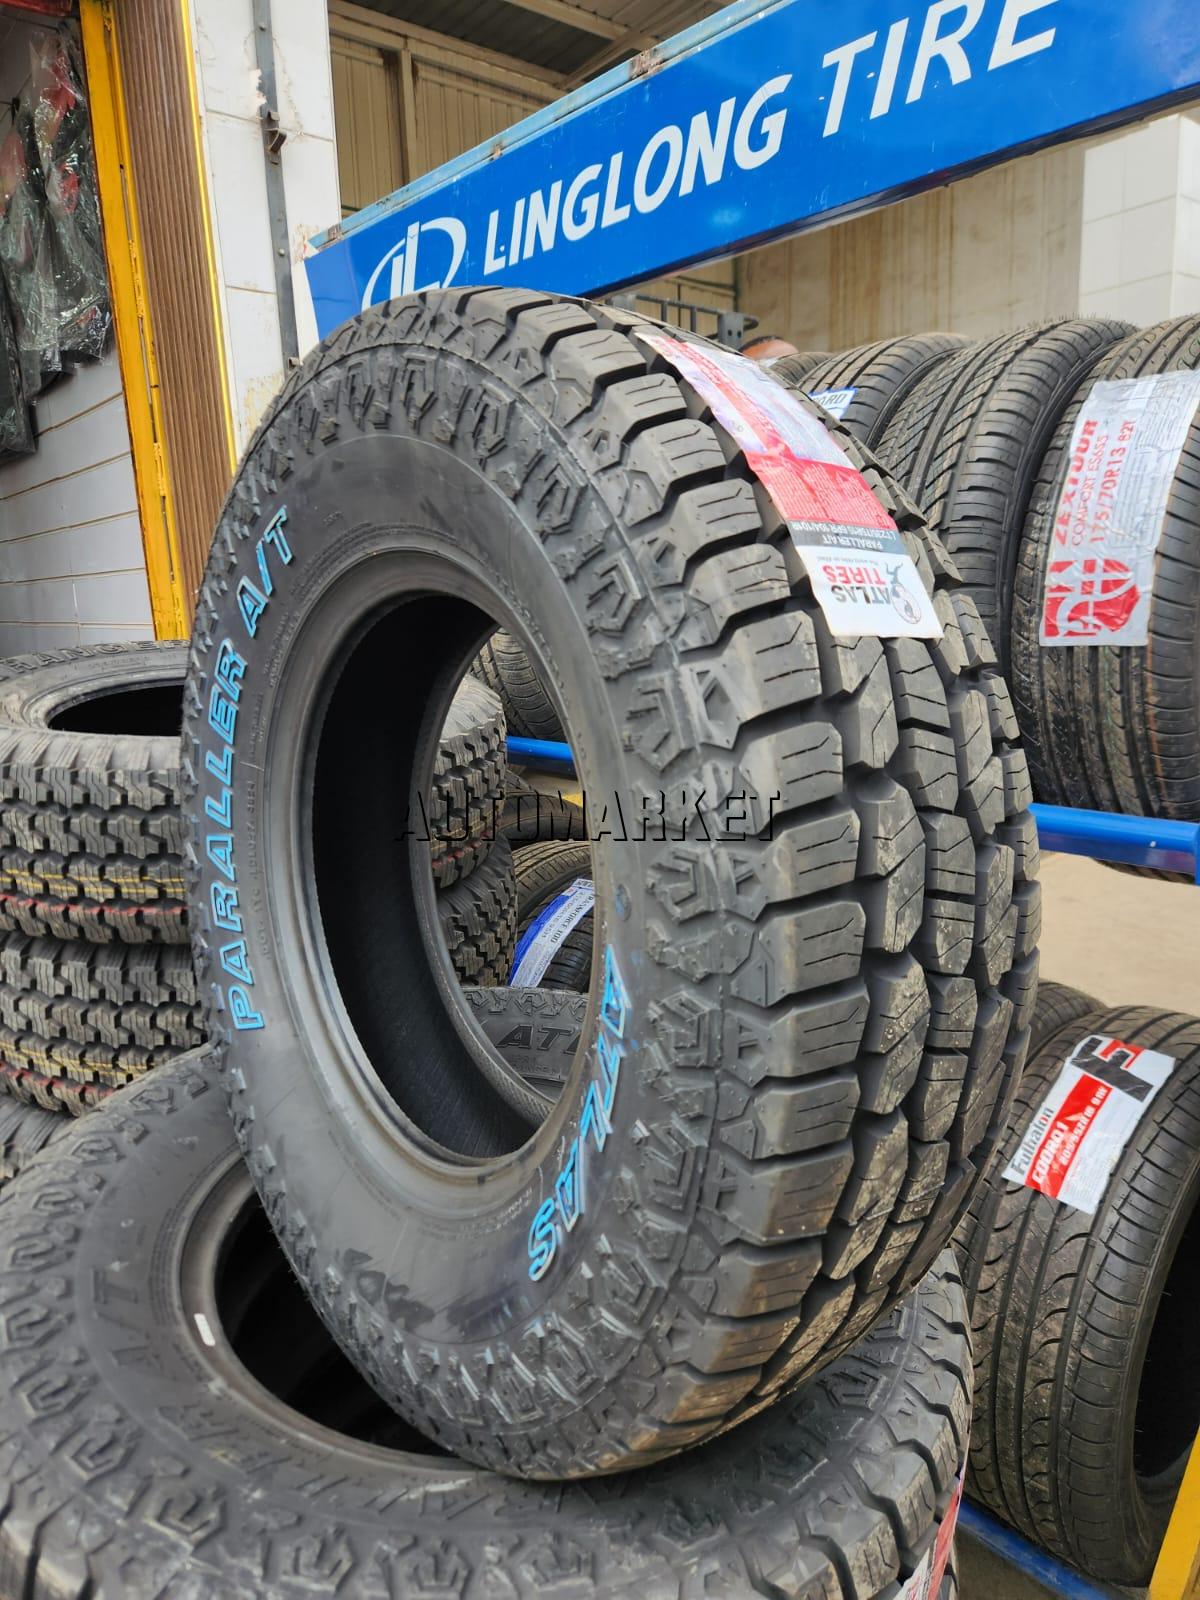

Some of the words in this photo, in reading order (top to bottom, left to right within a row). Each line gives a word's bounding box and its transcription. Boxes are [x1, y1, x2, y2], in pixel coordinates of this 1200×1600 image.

[483, 73, 792, 277] LINGLONG
[821, 0, 1063, 139] TIRE
[812, 392, 848, 406] ARD
[1055, 419, 1098, 546] ZEXTOUR
[1071, 474, 1096, 547] COMFORT
[1089, 446, 1127, 543] 175/70R13
[821, 564, 887, 586] TIRES
[838, 536, 884, 549] PARALLER
[830, 584, 892, 605] ATLAS
[204, 637, 264, 1031] PARALLER
[236, 504, 294, 638] A/T
[527, 943, 633, 1282] ATLAS
